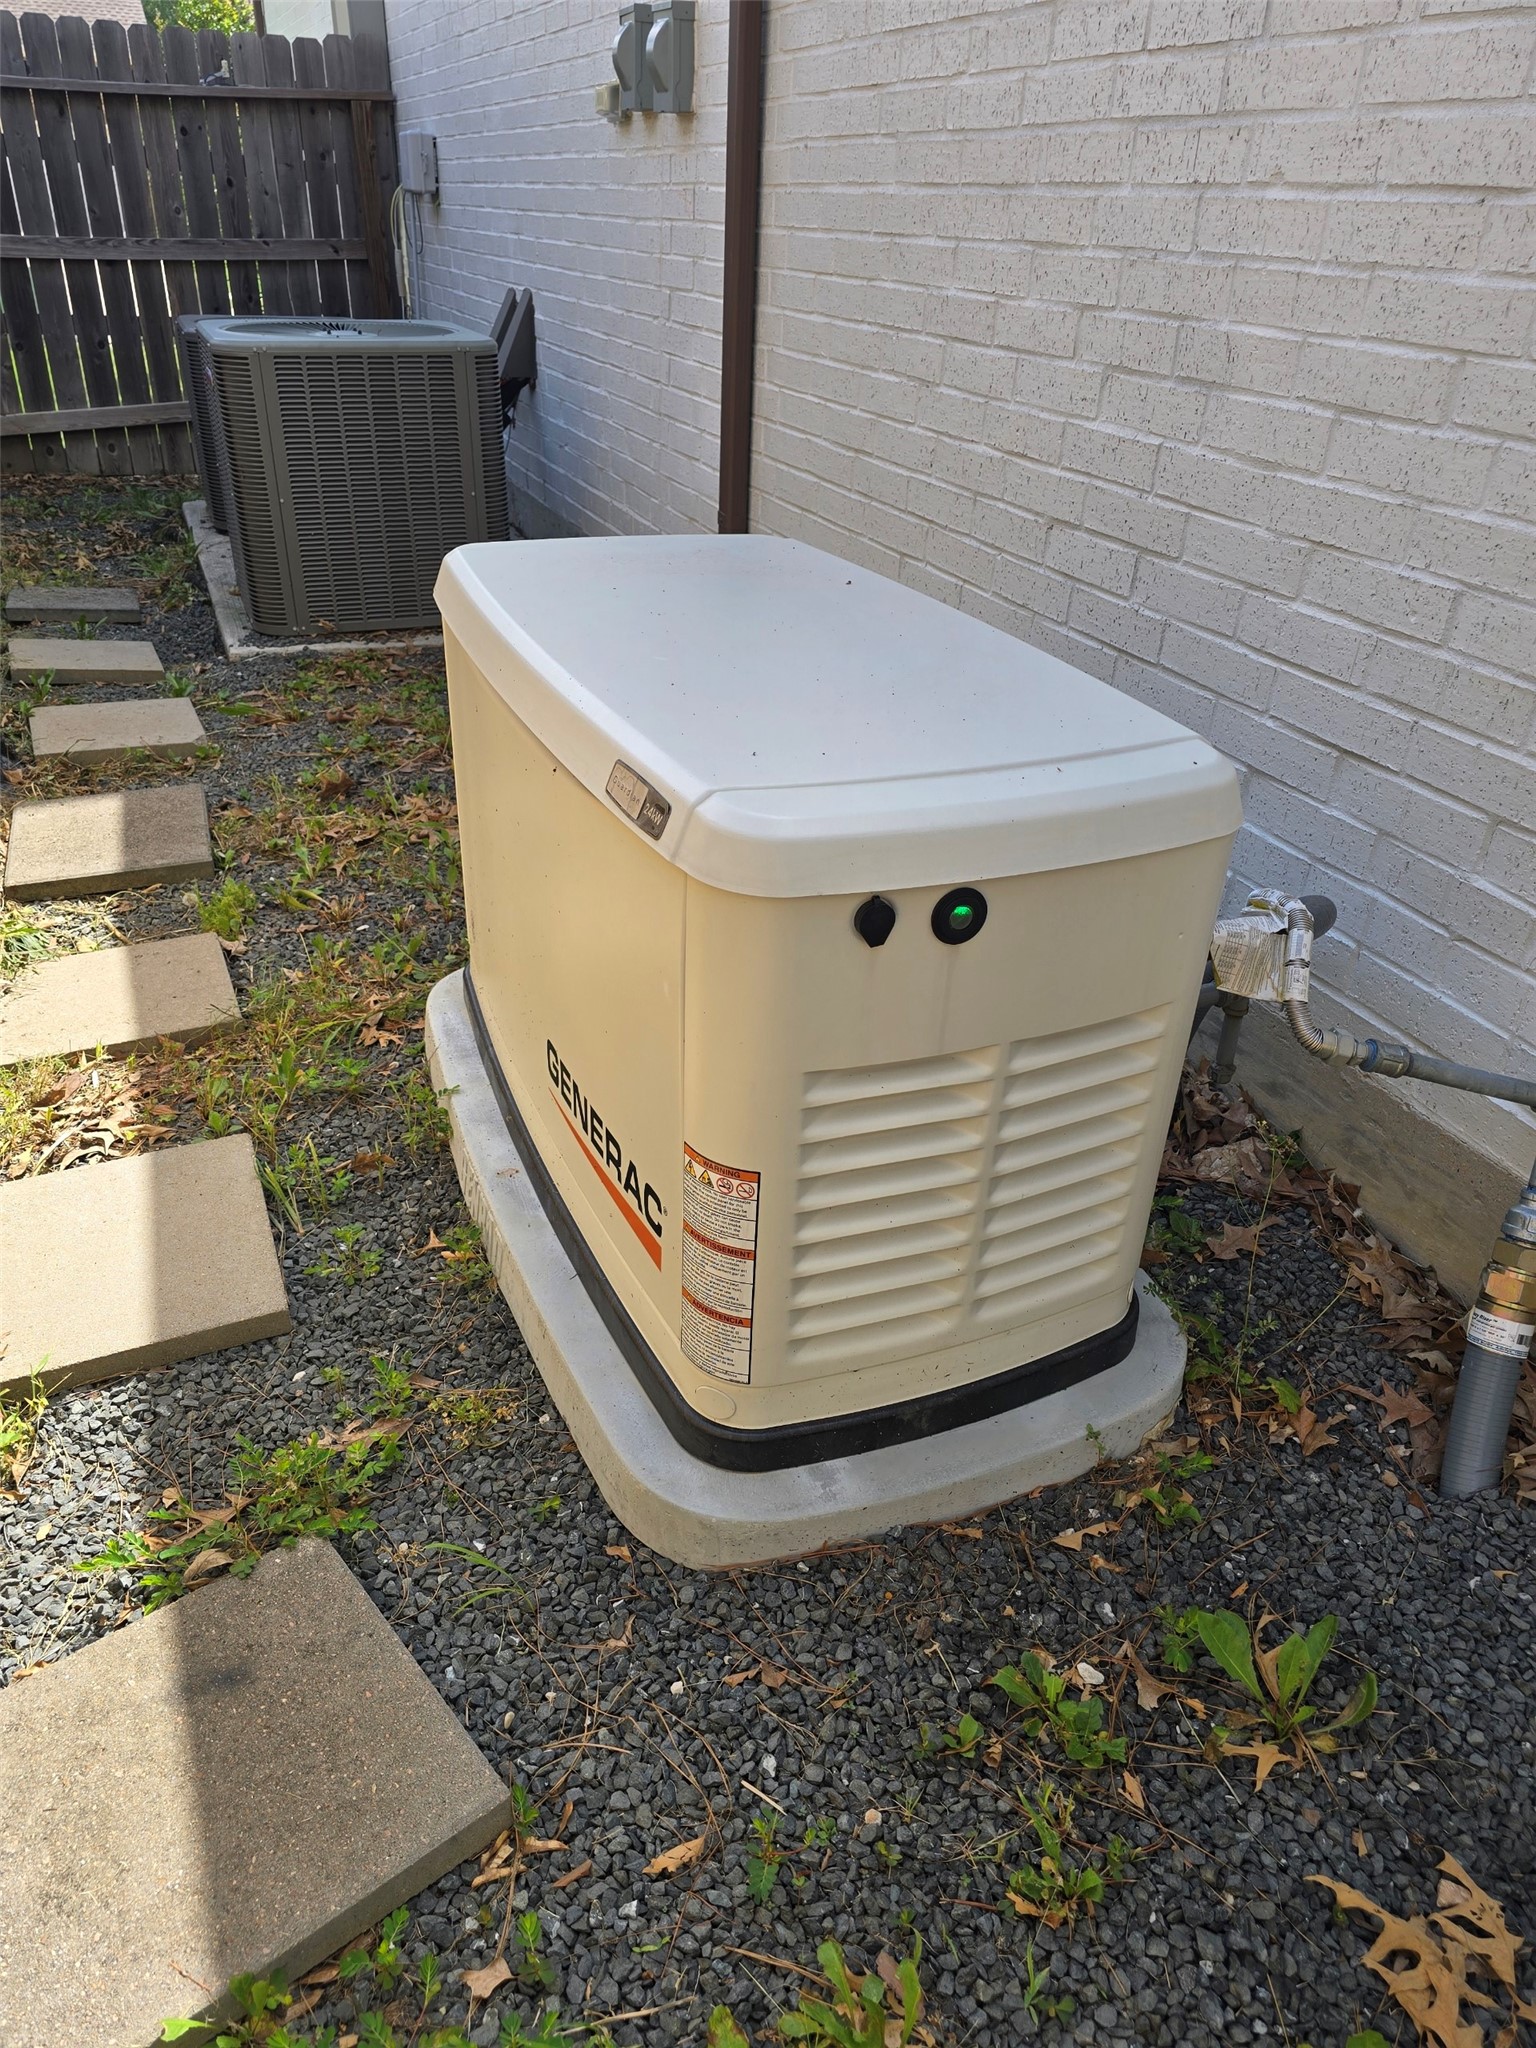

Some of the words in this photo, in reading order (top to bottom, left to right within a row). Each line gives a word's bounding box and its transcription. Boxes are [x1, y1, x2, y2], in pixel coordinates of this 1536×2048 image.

[546, 1038, 663, 1238] GENERAC
[703, 1160, 741, 1178] WARNING
[689, 1229, 752, 1258] AVERTISSEMENT
[691, 1298, 744, 1326] ADVERTENCIA
